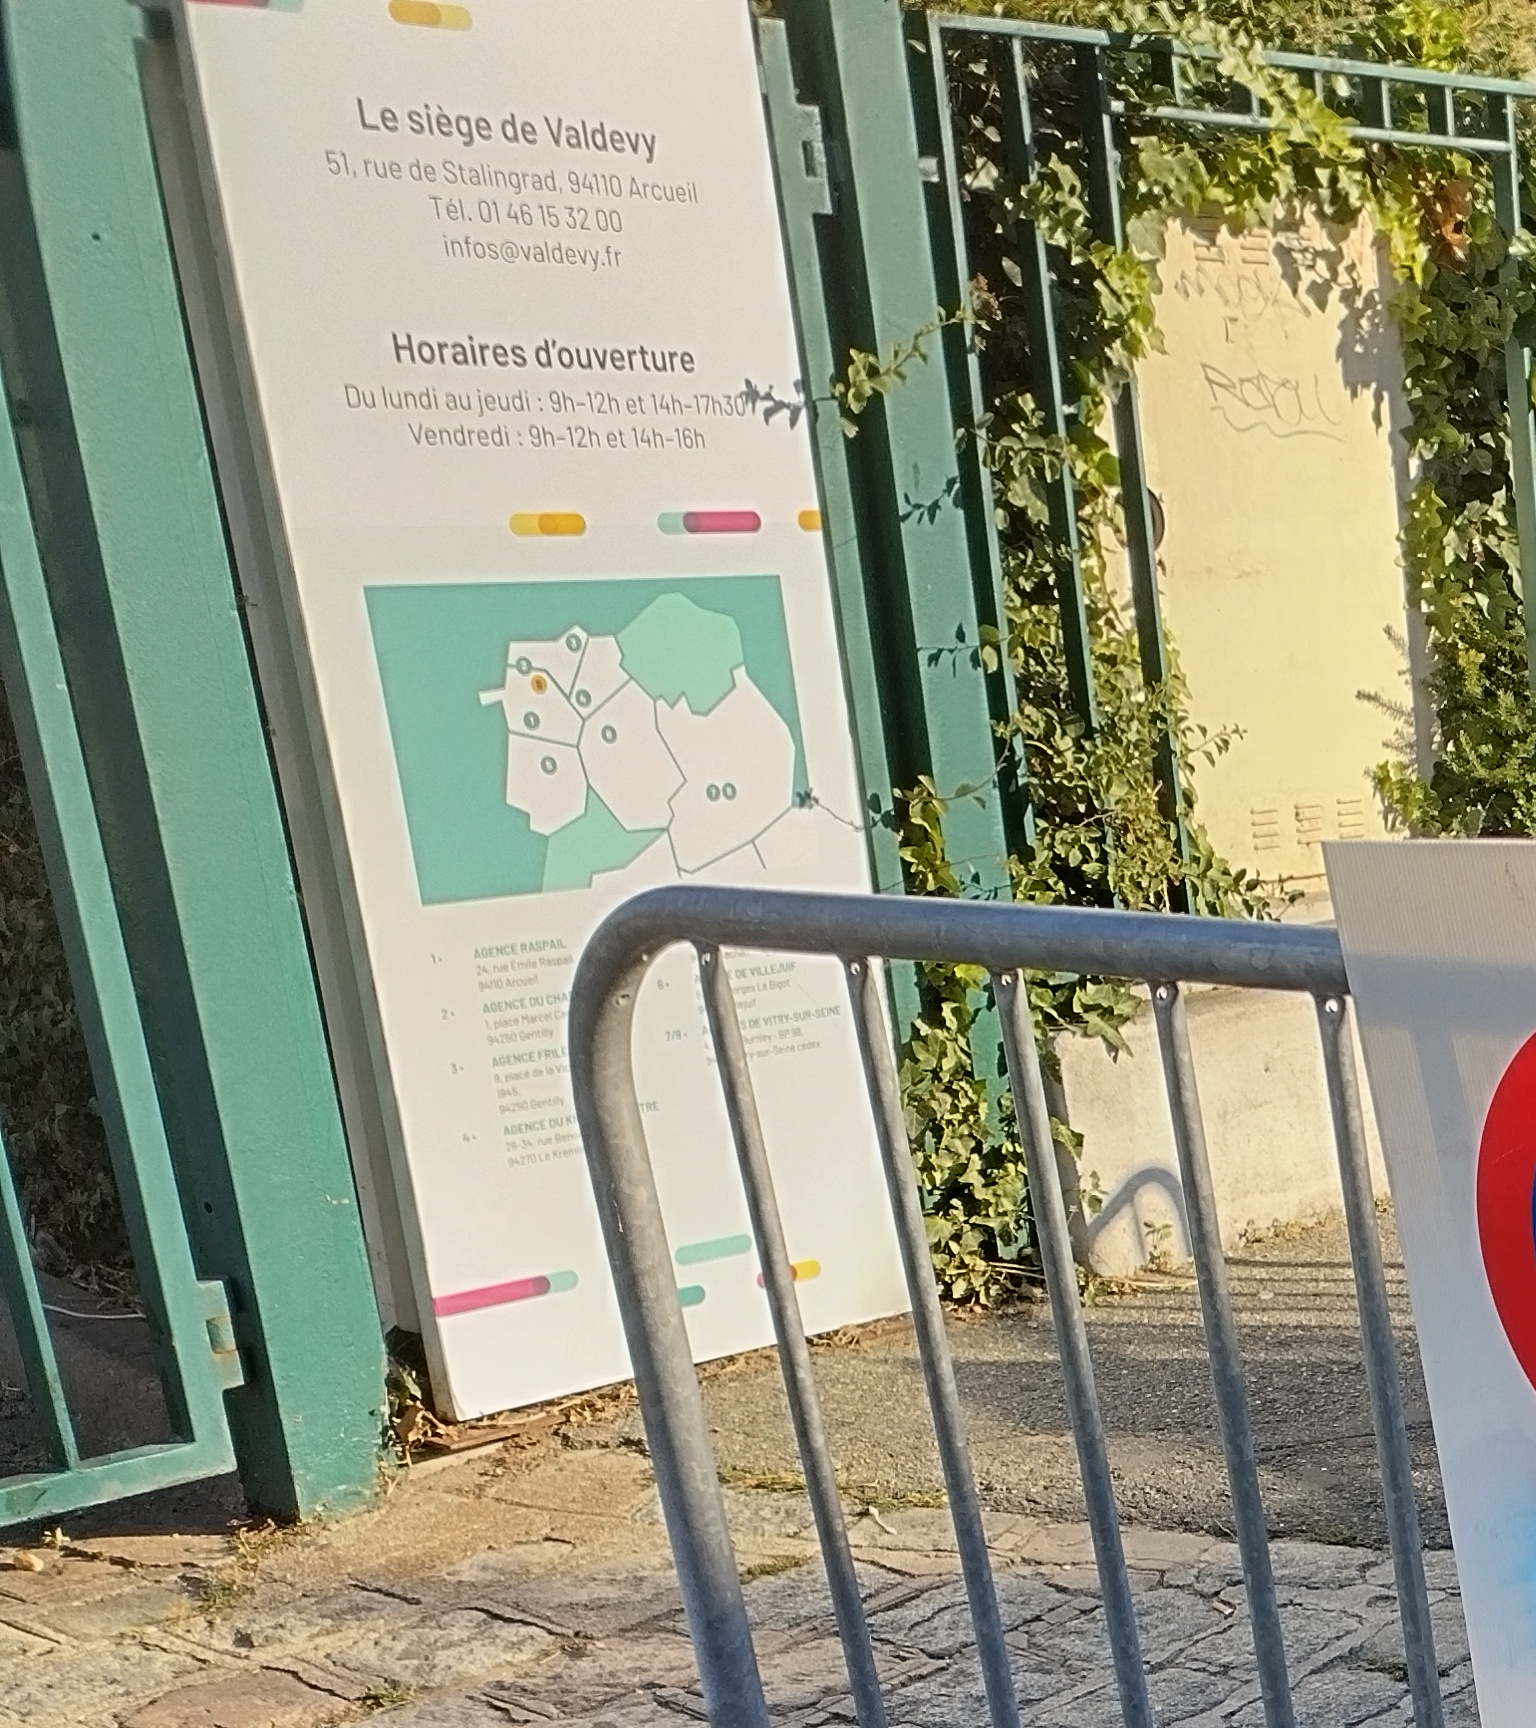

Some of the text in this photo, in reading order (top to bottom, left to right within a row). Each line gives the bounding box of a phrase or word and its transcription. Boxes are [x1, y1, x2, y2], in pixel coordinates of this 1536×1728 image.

[357, 97, 656, 163] Le siège de Valdevy
[325, 150, 699, 204] 51, rue de Stalingrad, 94110 Arcueil
[429, 195, 623, 233] Tél. 01 46 15 32 00
[443, 235, 622, 271] infos@valdevy.fr
[392, 332, 695, 373] Horaires d'ouverture
[344, 383, 376, 409] Du
[383, 386, 438, 411] lundi
[446, 392, 472, 412] au
[477, 388, 529, 417] jeudi
[625, 394, 646, 415] et
[408, 422, 509, 448] Vendredi
[606, 429, 626, 449] et
[474, 943, 519, 960] AGENCE
[520, 938, 567, 954] RASPAIL
[493, 964, 509, 974] rue
[749, 961, 796, 977] VILLEJUIF
[505, 975, 539, 989] Arcueil
[731, 985, 756, 997] orges
[483, 999, 527, 1014] AGENCE
[529, 995, 544, 1007] DU
[546, 991, 571, 1006] CHA
[494, 1016, 519, 1030] place
[521, 1011, 553, 1024] Marcel
[762, 1006, 841, 1026] VITRY-SUR-SEINE
[519, 1028, 554, 1041] Gentilly
[492, 1051, 536, 1068] AGENCE
[503, 1119, 546, 1136] AGENCE
[548, 1116, 564, 1129] DU
[537, 1136, 553, 1147] rue
